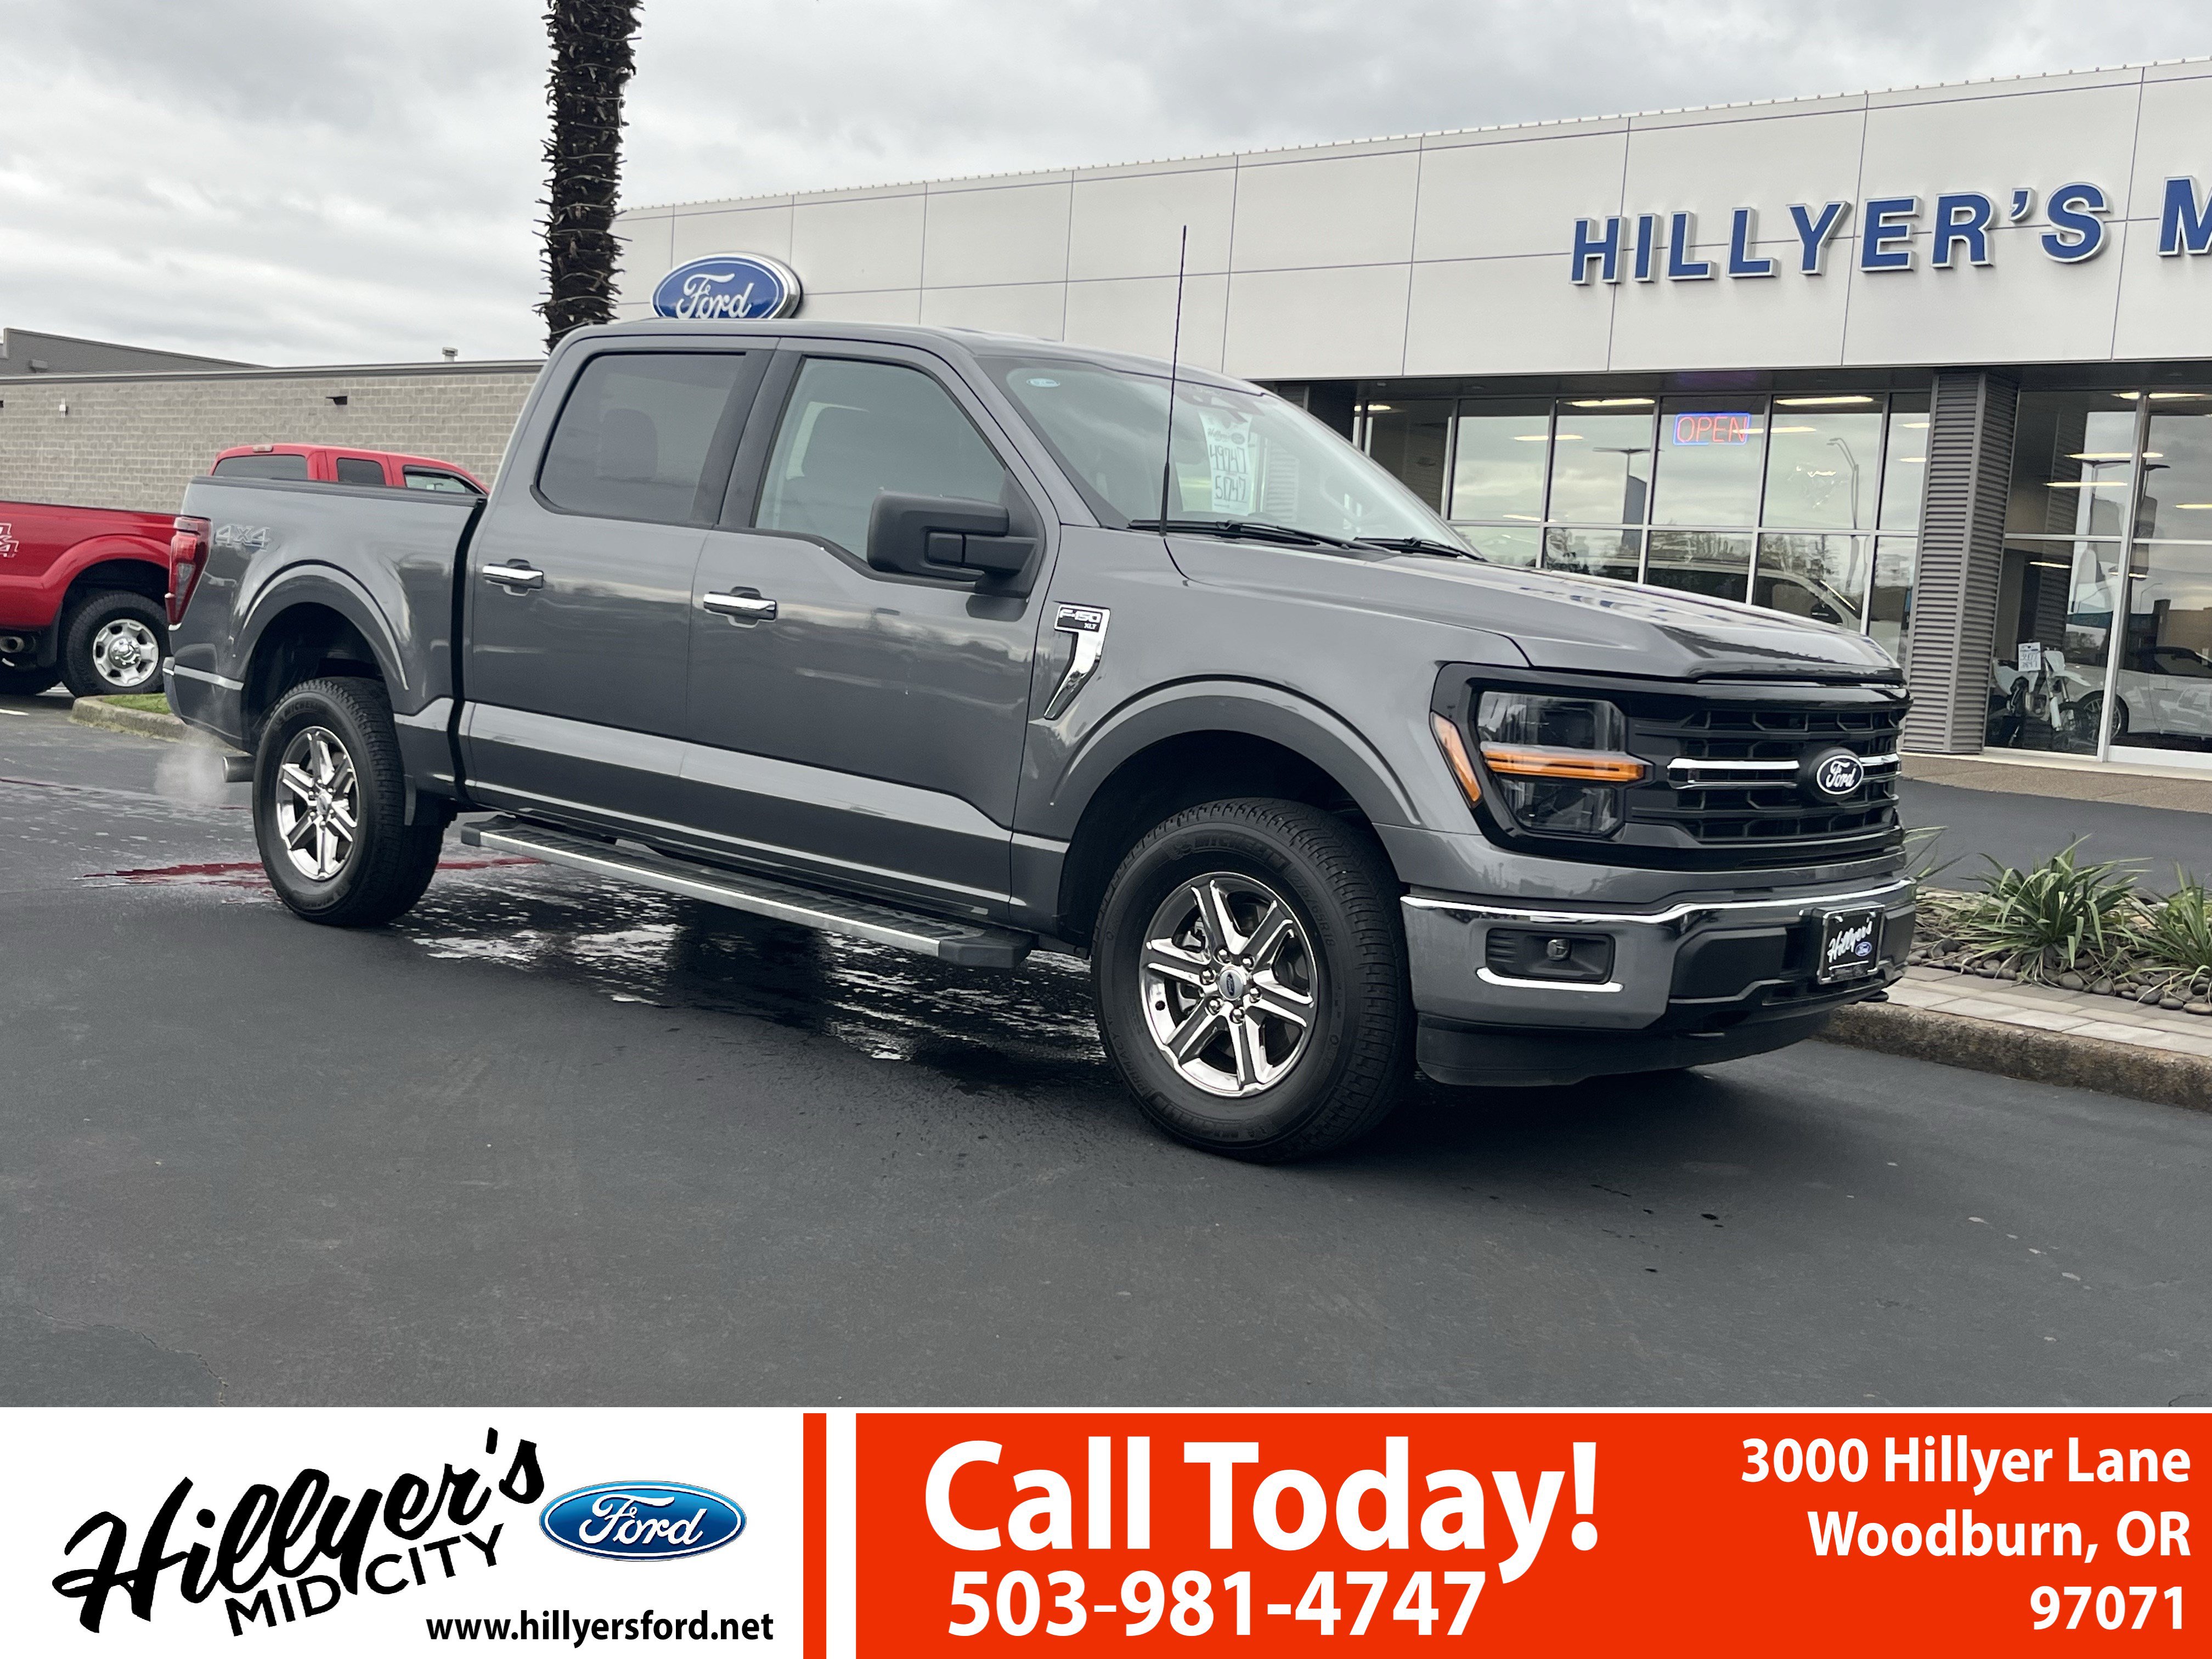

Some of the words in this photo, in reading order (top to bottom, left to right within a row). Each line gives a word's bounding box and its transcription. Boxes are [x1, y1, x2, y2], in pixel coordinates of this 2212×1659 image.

[1569, 181, 2112, 285] HILLYER'S
[676, 273, 755, 319] Ford
[1677, 415, 1748, 443] OPEN
[1058, 608, 1102, 623] F-150
[1825, 760, 1857, 788] Ford
